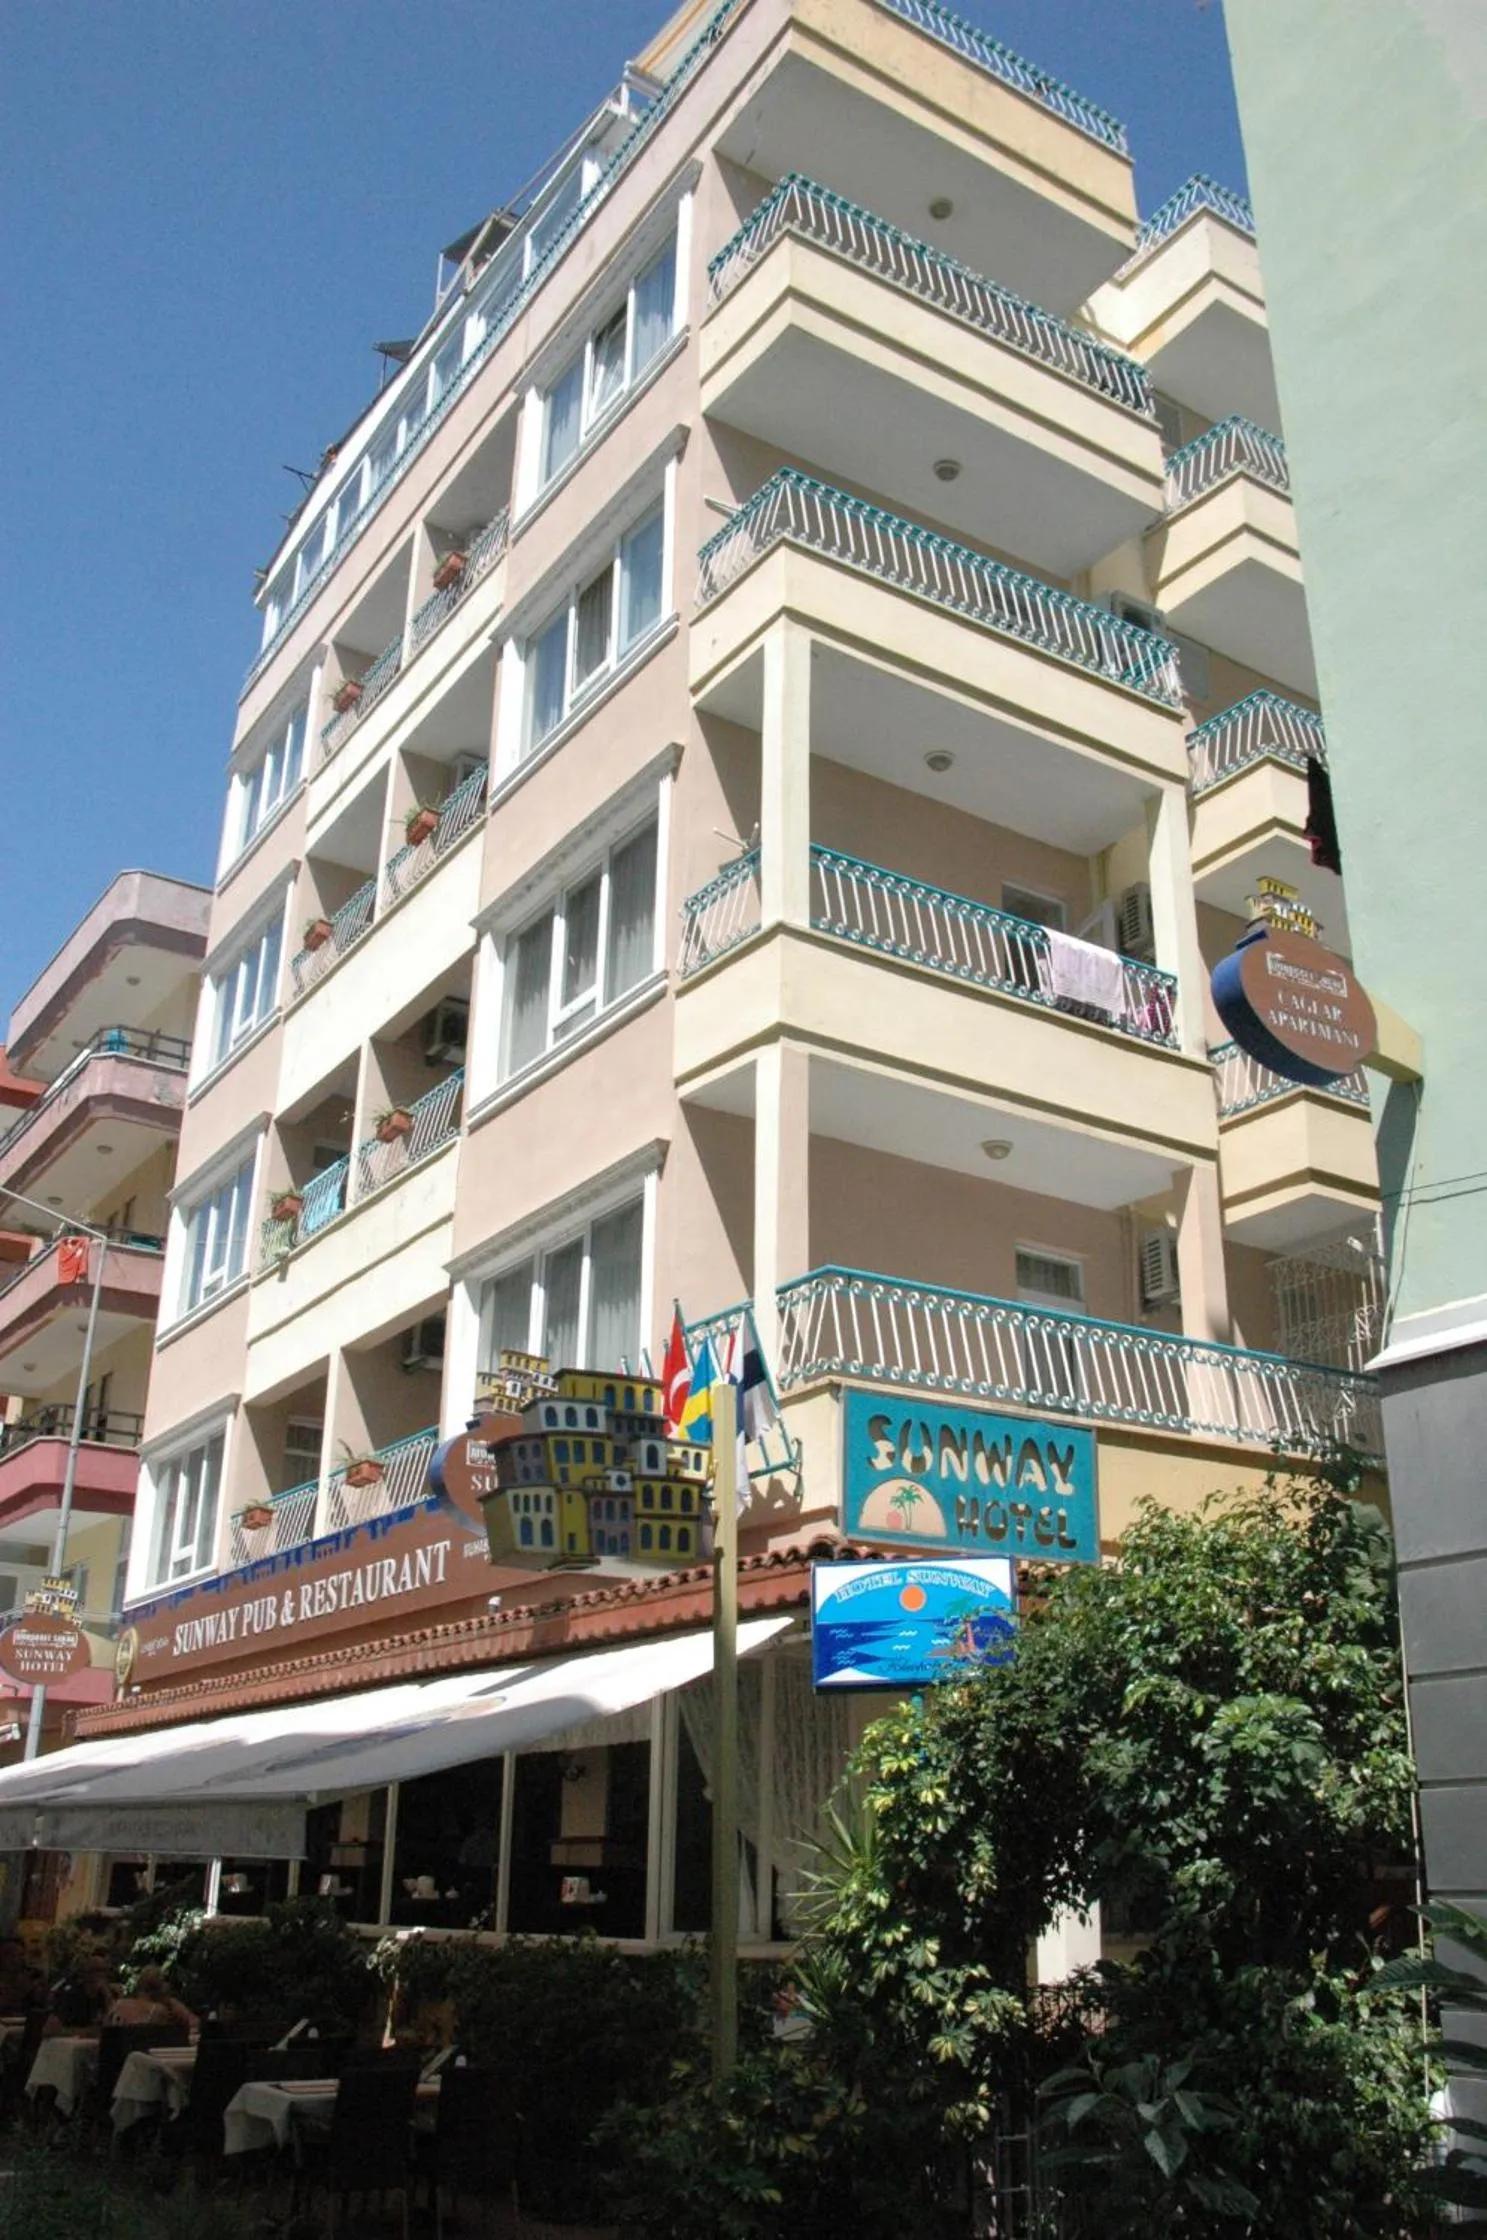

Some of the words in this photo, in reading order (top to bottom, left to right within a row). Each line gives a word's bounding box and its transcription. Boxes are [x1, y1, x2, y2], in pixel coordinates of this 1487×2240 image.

[867, 1414, 1075, 1496] SUNWAY
[956, 1495, 1077, 1549] HOTEL
[172, 1606, 243, 1656] SUNWAY
[240, 1597, 277, 1637] PUB
[280, 1590, 295, 1626] &
[299, 1540, 451, 1621] RESTAURANT
[835, 1571, 903, 1603] HOTEL
[906, 1568, 993, 1598] SUNWAY
[15, 1648, 73, 1661] SUNWAY
[20, 1661, 66, 1672] HOTEL
